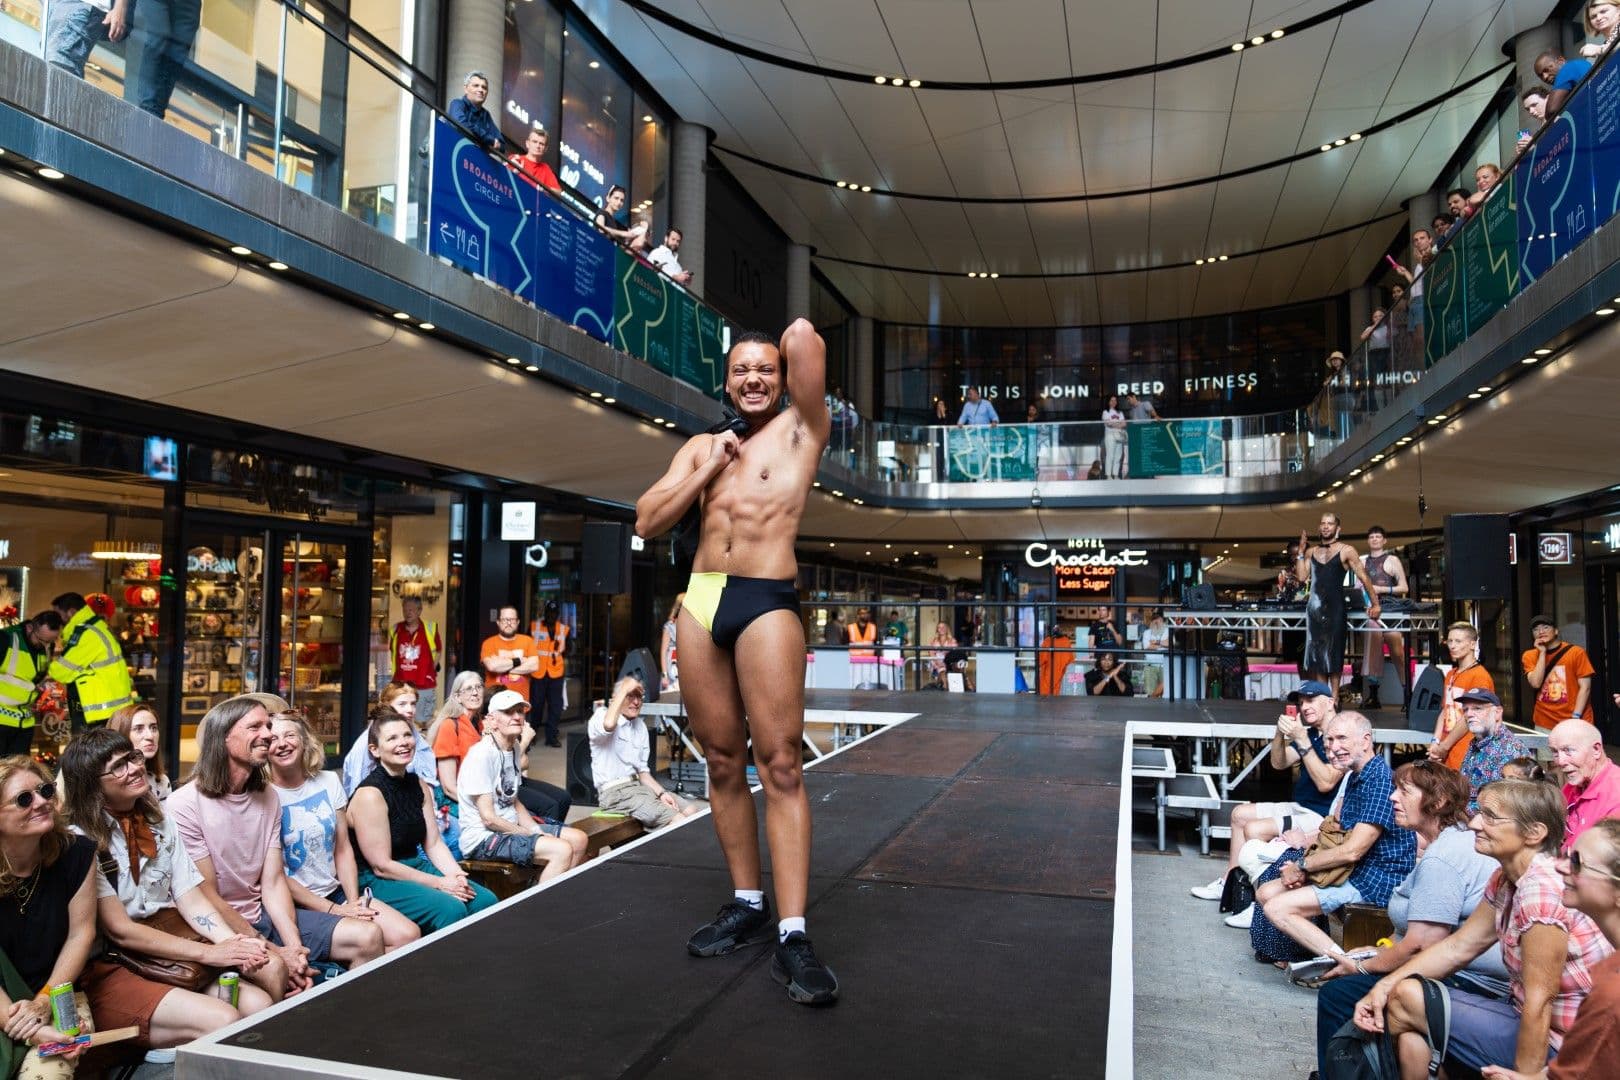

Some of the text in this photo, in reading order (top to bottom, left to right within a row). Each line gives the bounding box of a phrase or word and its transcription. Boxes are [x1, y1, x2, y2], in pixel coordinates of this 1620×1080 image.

[463, 159, 513, 199] BROADGATE
[1541, 158, 1560, 184] CIRCLE
[474, 181, 501, 205] CIRCLE
[960, 372, 1258, 399] TIS IS JOHN REED FITNESS
[1067, 538, 1105, 549] HOTEL
[1054, 565, 1116, 576] More Cacao
[1059, 578, 1110, 592] Less Sugar
